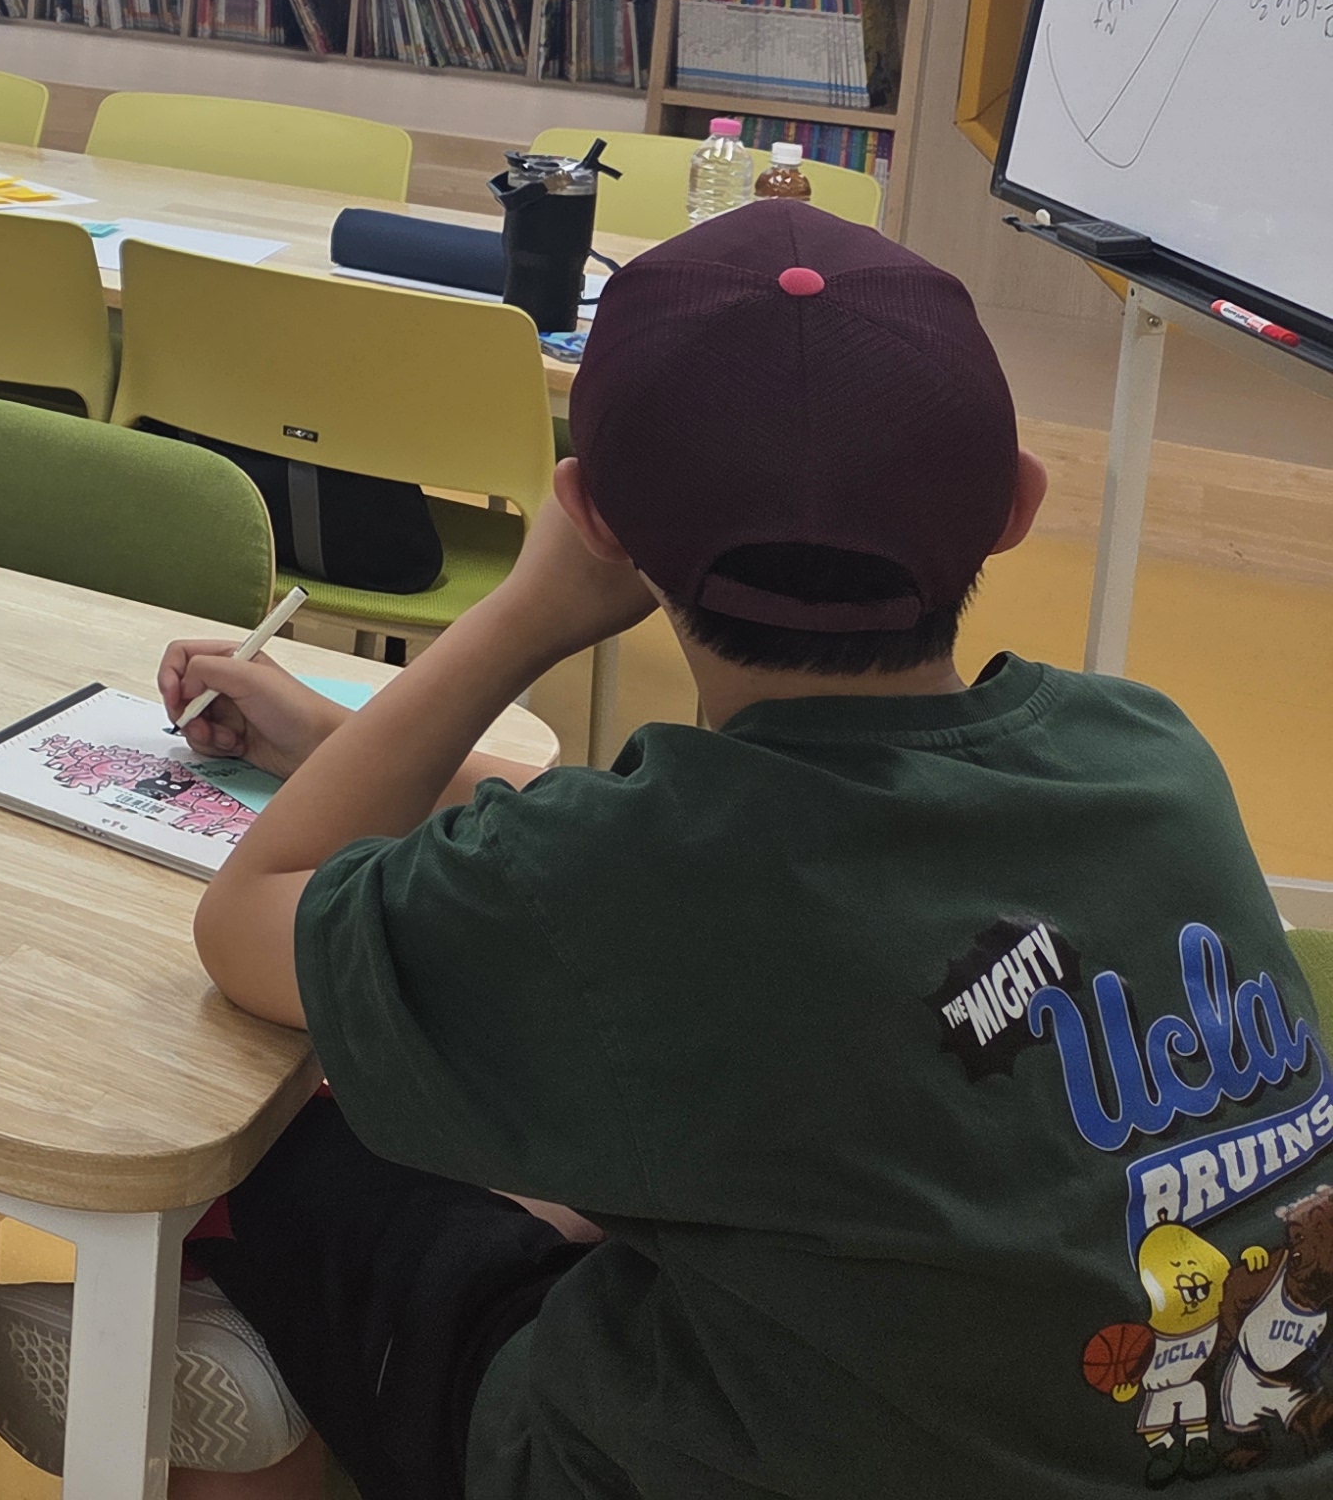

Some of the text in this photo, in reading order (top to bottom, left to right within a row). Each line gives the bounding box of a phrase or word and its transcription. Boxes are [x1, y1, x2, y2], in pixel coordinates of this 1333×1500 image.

[940, 921, 1065, 1047] THE MIGHTY
[1140, 1093, 1333, 1230] BRUINS
[1153, 1339, 1209, 1371] UCLA
[1268, 1318, 1319, 1350] UCLA
